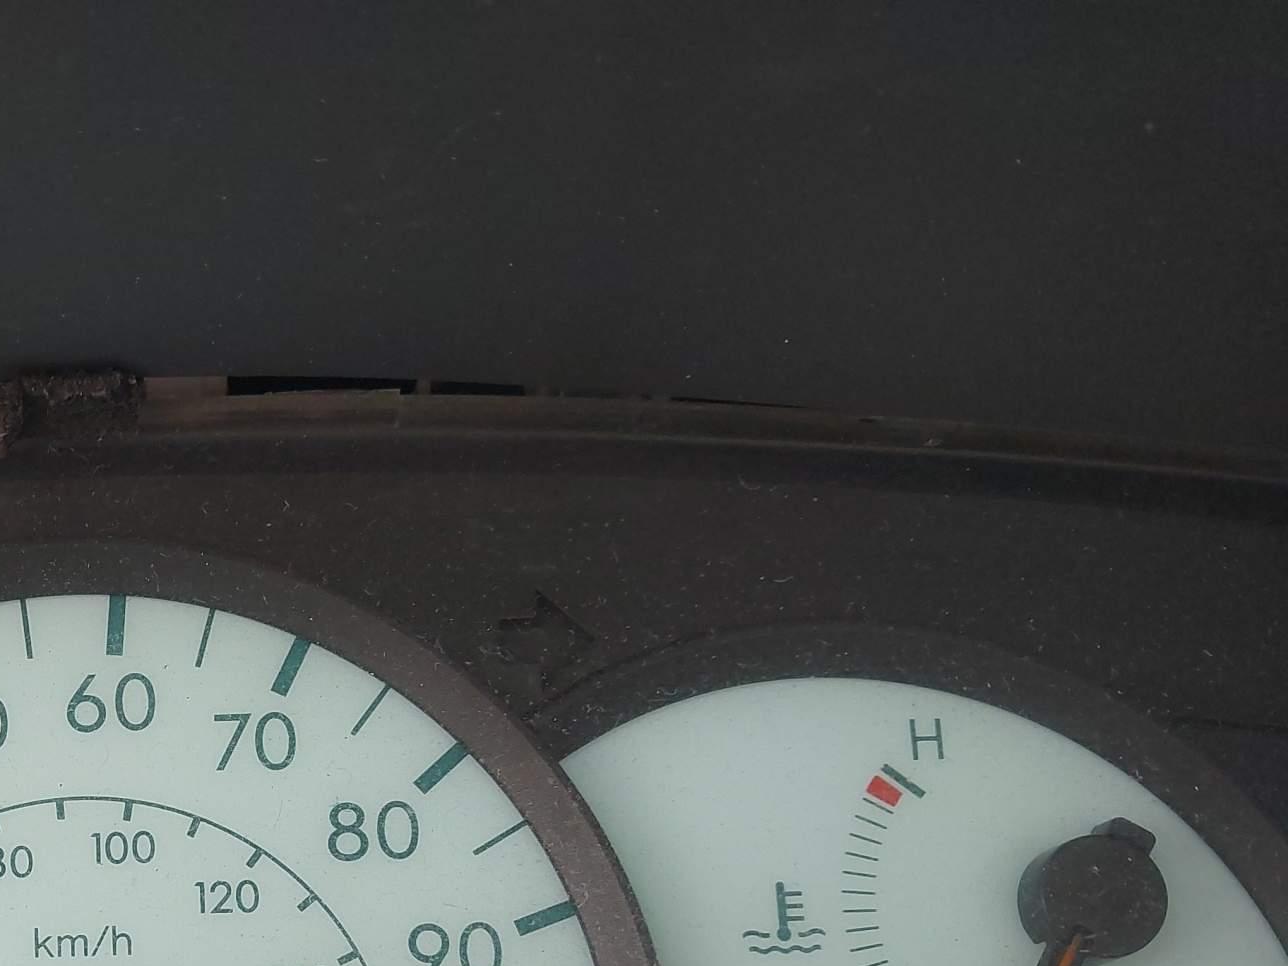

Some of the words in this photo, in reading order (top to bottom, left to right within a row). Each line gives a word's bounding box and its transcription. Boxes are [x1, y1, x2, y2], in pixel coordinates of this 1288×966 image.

[66, 673, 156, 732] 60
[213, 711, 297, 771] 70
[909, 718, 944, 760] H
[90, 830, 156, 864] 100
[327, 800, 420, 862] 80
[194, 879, 260, 914] 120
[33, 926, 133, 958] km/h
